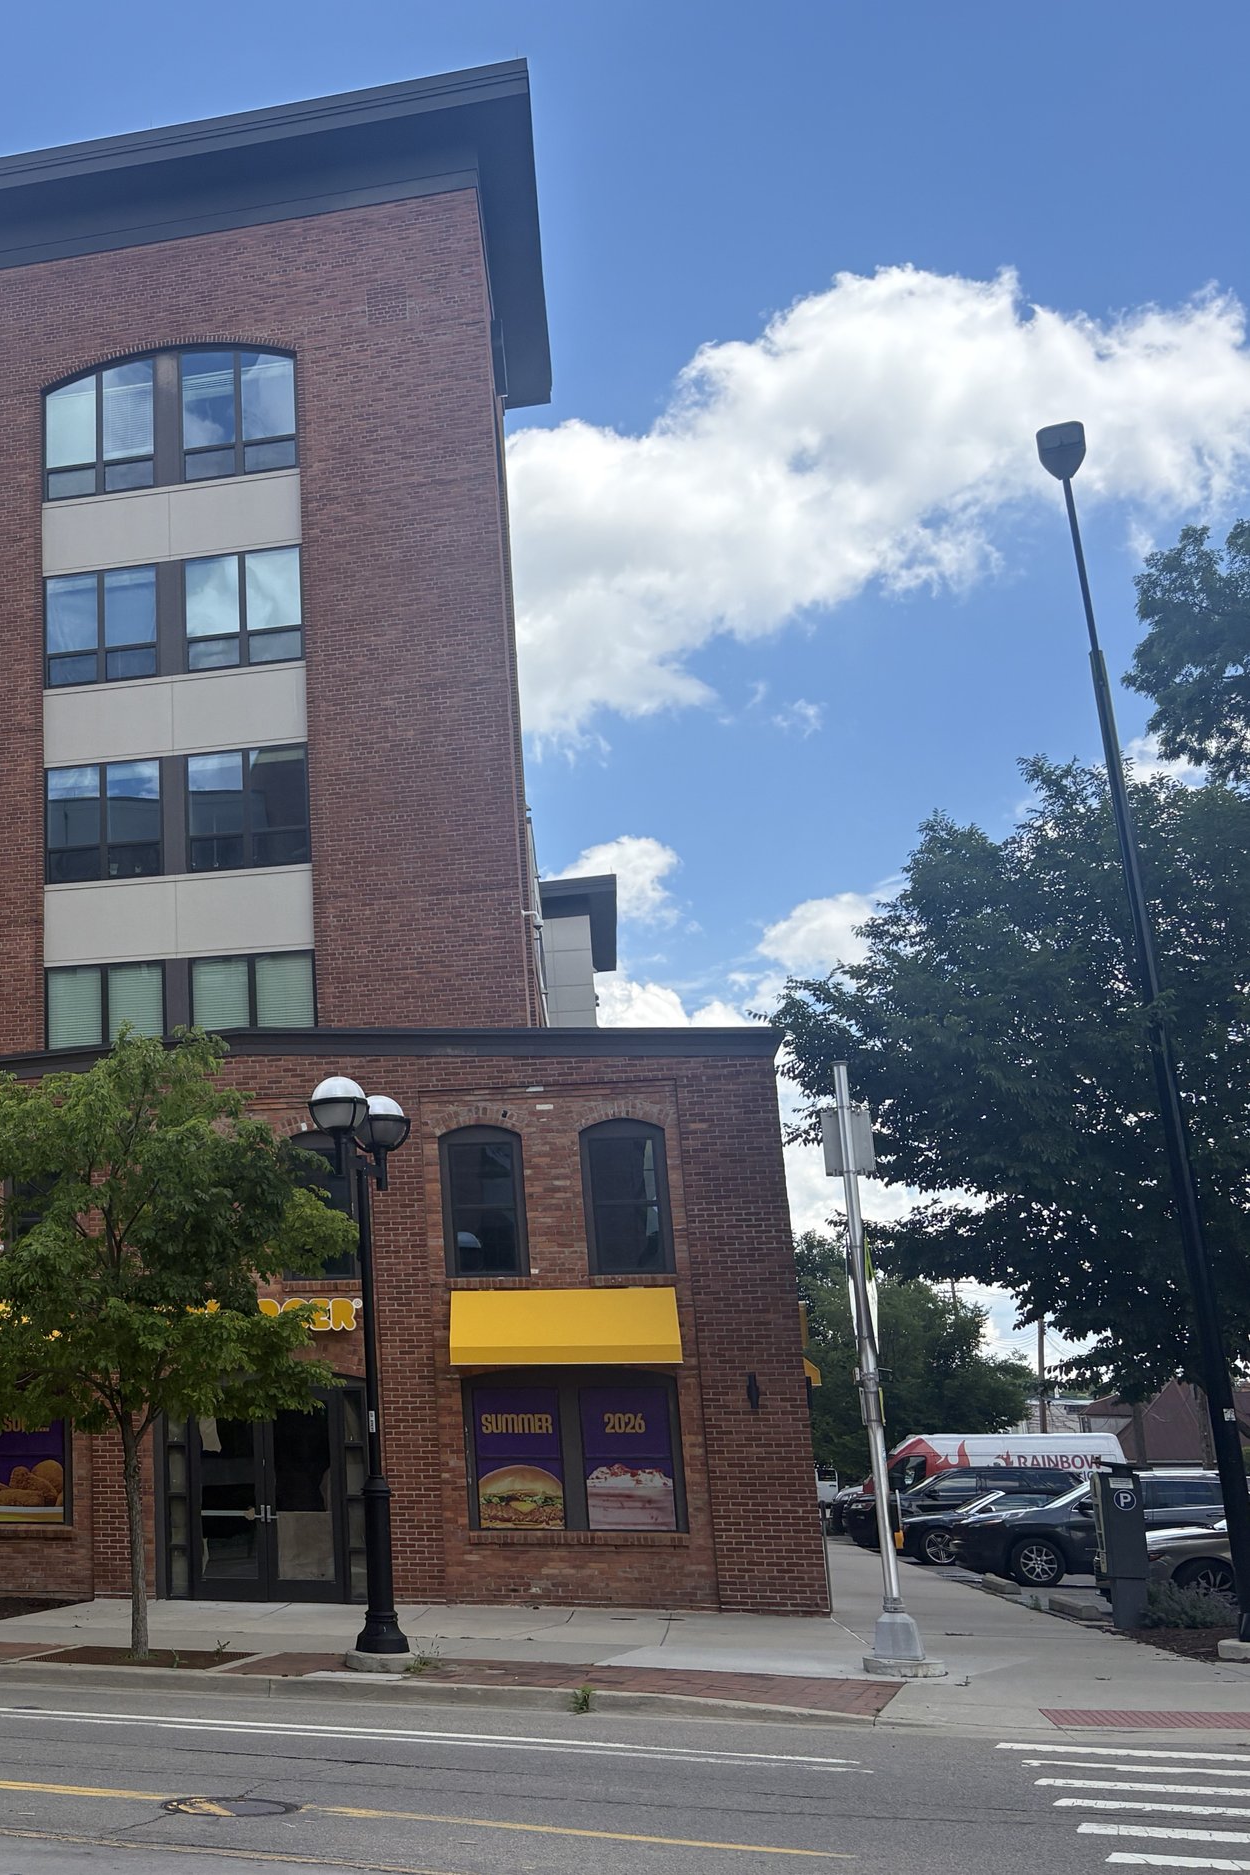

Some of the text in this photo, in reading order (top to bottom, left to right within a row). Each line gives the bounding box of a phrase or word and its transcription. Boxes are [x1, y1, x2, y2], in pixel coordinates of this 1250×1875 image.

[481, 1413, 646, 1434] SUMMER 2026
[1017, 1455, 1101, 1470] RAINBOW
[1119, 1493, 1131, 1507] P
